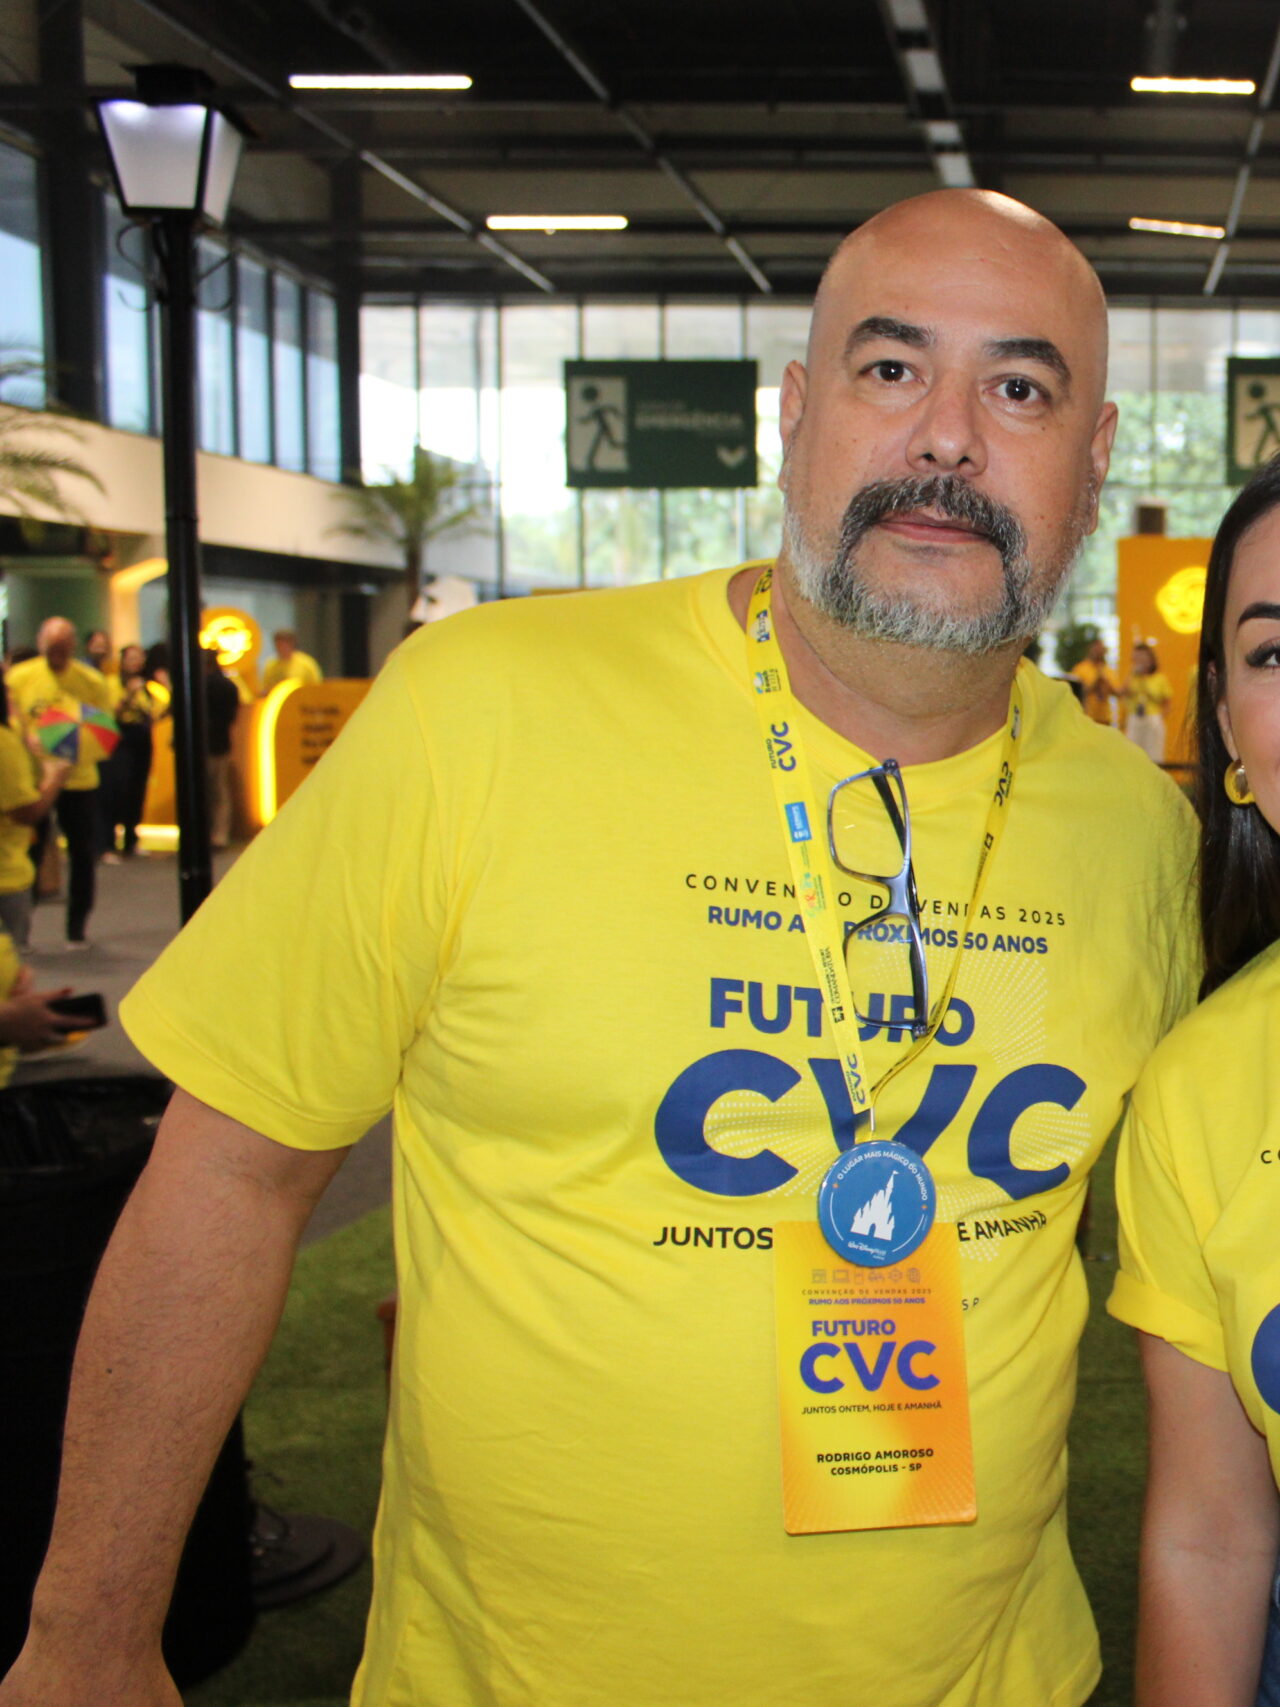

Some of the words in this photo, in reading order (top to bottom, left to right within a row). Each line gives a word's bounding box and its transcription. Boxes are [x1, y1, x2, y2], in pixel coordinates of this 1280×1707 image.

[771, 721, 797, 772] CVC
[686, 874, 852, 907] CONVENO
[1018, 908, 1066, 926] 2025
[708, 905, 782, 931] RUMO
[963, 932, 988, 950] 50
[993, 934, 1048, 954] ANOS
[842, 1156, 864, 1174] LUGAR
[864, 1150, 882, 1160] MAIS
[883, 1150, 909, 1166] MÁGICO
[908, 1161, 918, 1175] DO
[914, 1171, 928, 1201] MUNDO
[653, 1226, 773, 1250] JUNTOS
[974, 1210, 1047, 1240] AMANHÃ
[851, 1296, 892, 1305] PRÓXIMOS
[812, 1319, 896, 1336] FUTURO
[799, 1340, 941, 1394] CVC
[801, 1405, 837, 1415] JUNTOS
[839, 1403, 871, 1413] ONTEM,
[873, 1403, 894, 1412] HOJE
[897, 1403, 903, 1411] E
[904, 1400, 942, 1410] AMANHÃ
[817, 1451, 871, 1463] RODRIGO
[875, 1448, 934, 1460] AMOROSO
[831, 1463, 898, 1475] COSMÓPOLIS
[909, 1463, 922, 1471] SP
